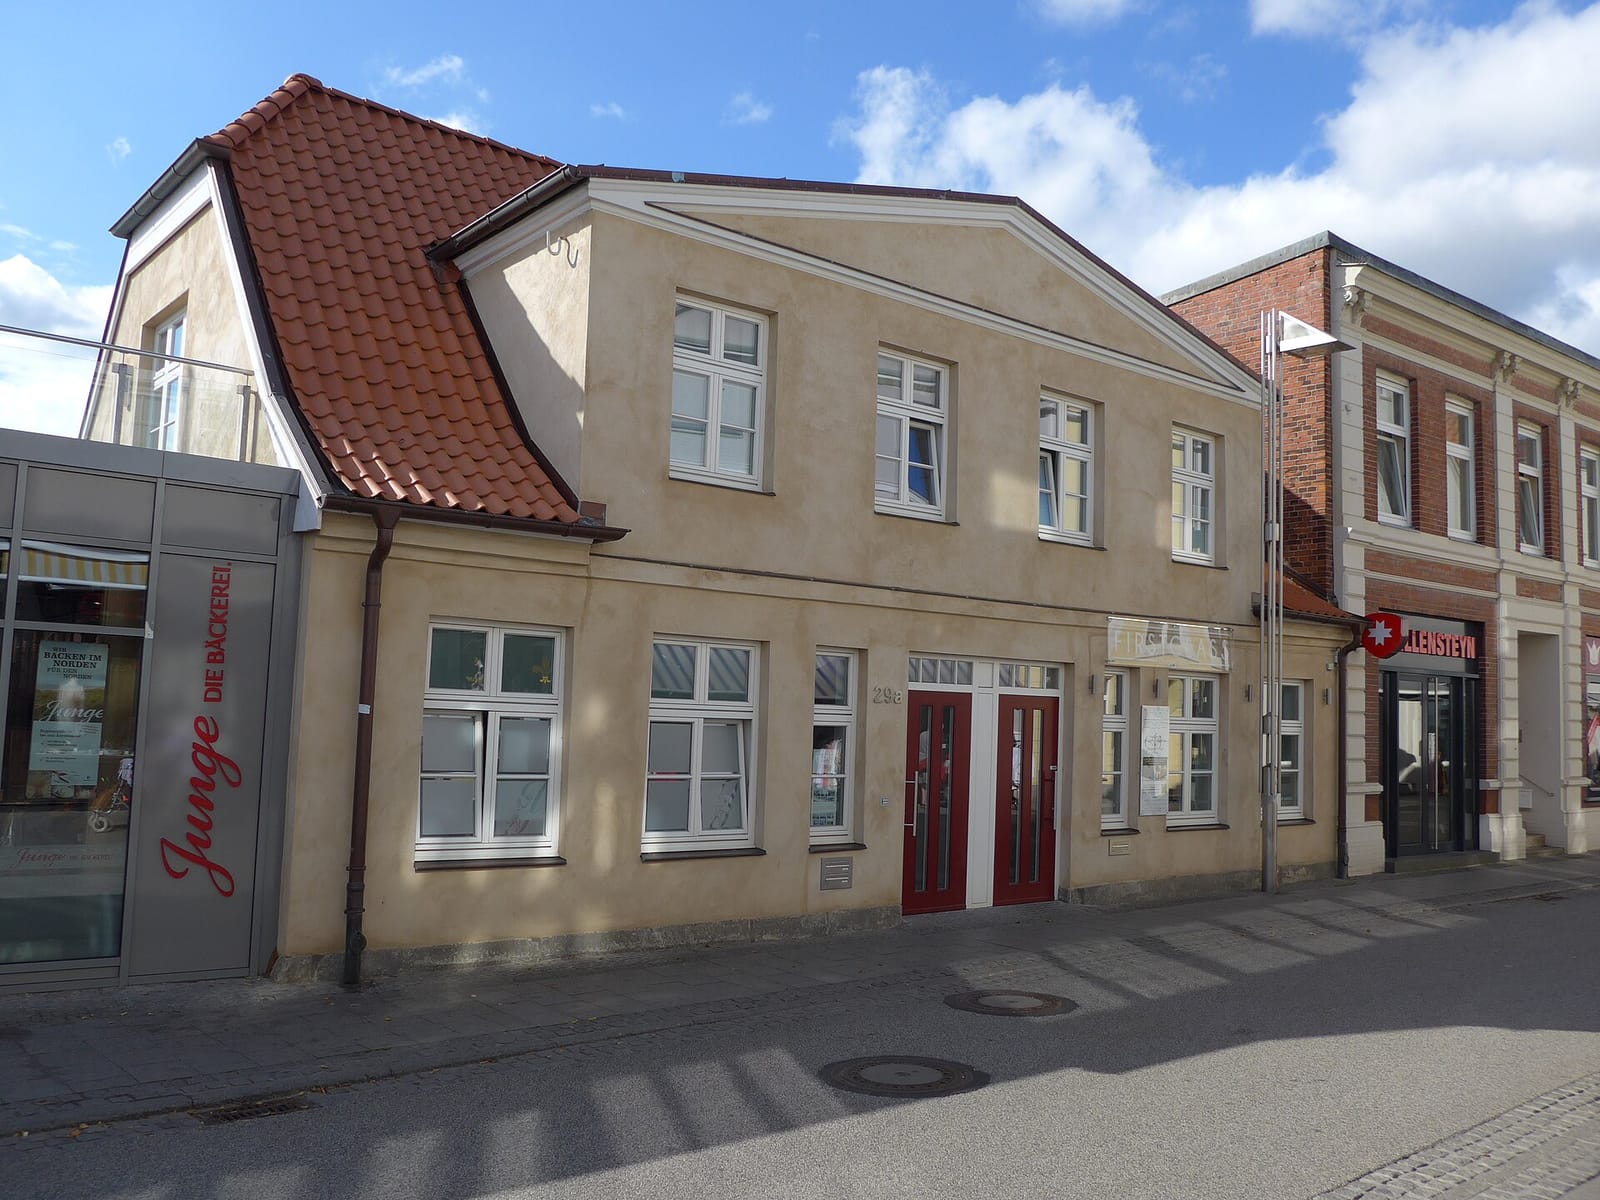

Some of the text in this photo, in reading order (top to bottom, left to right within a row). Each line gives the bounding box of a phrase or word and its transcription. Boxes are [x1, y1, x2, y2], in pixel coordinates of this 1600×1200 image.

[43, 652, 102, 662] BACKEN IM
[52, 660, 97, 669] NORDEN
[160, 562, 242, 897] Junge DIE BÄCKEREI.
